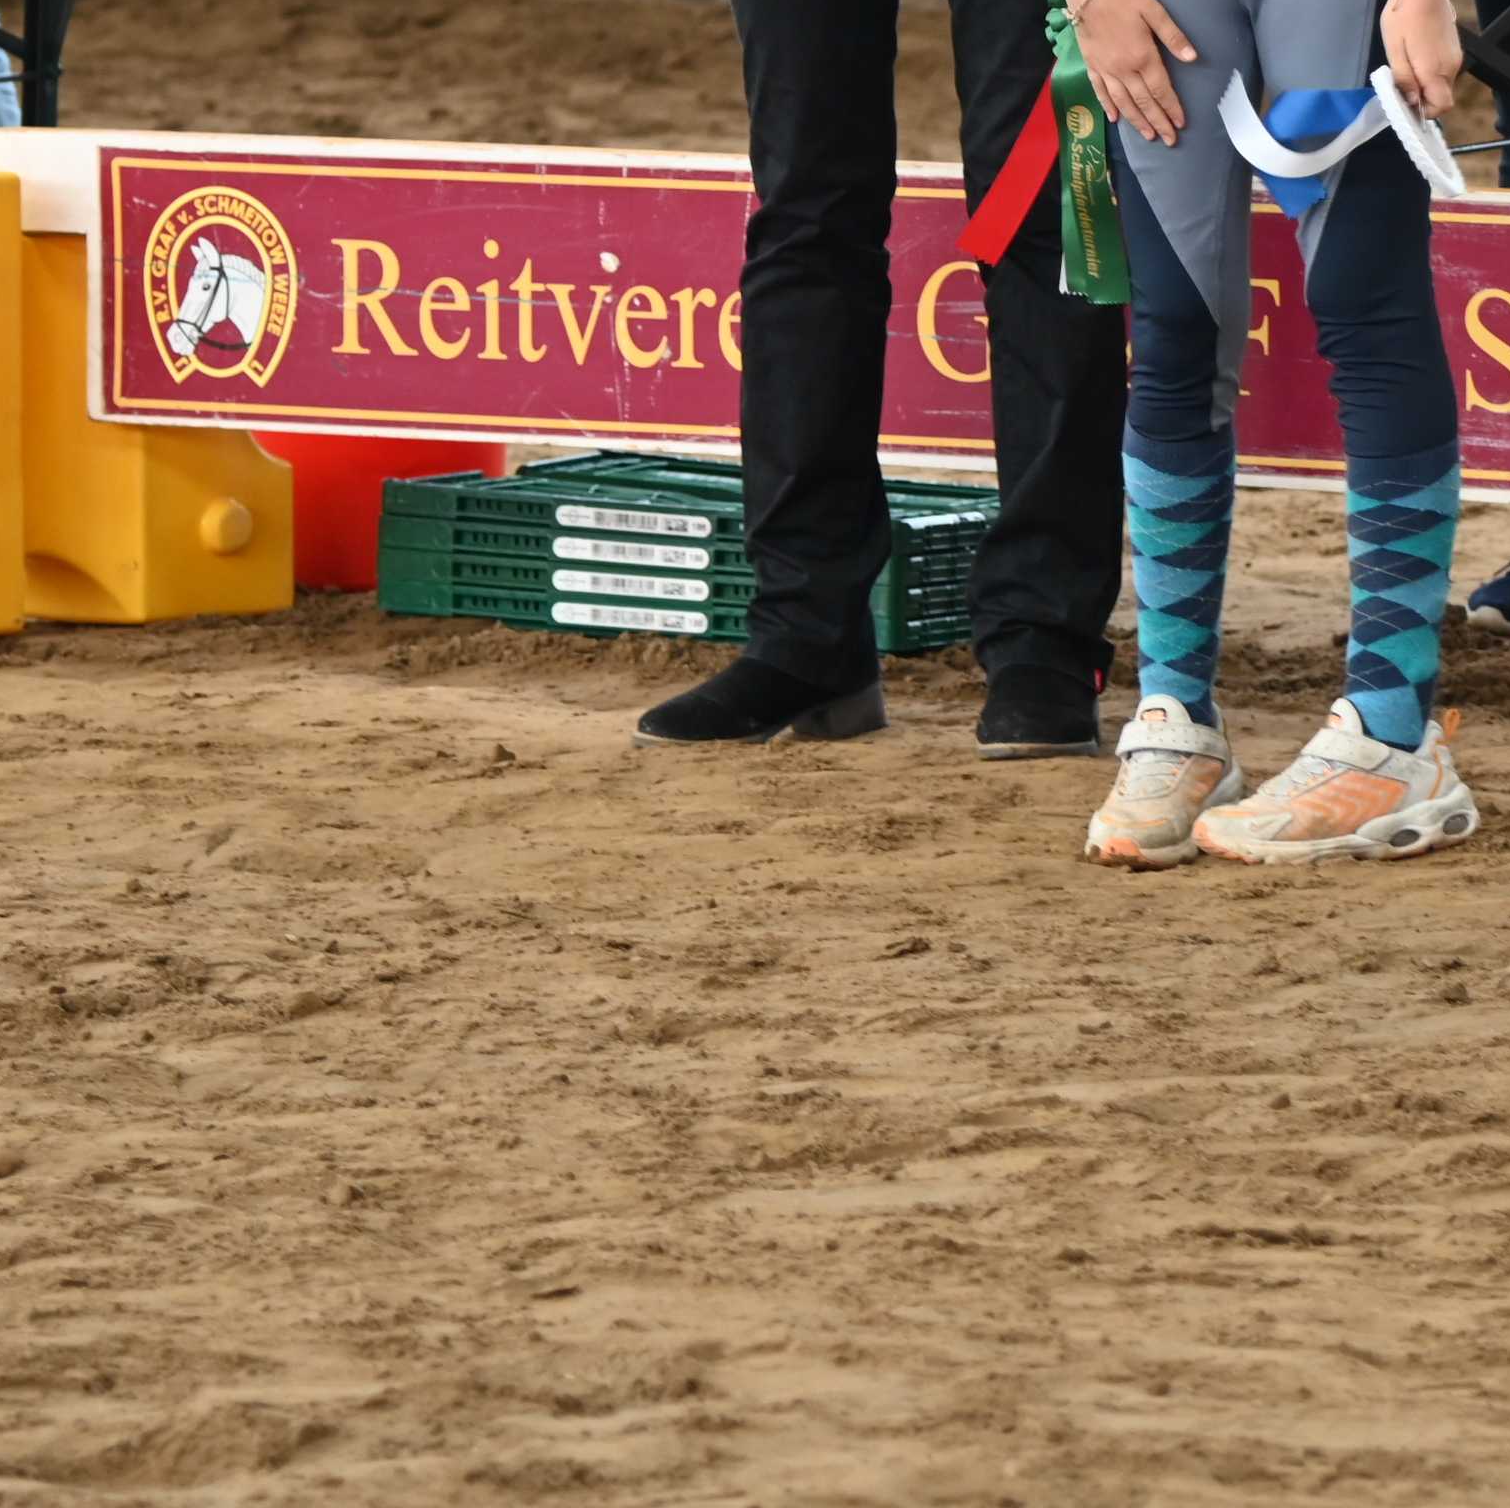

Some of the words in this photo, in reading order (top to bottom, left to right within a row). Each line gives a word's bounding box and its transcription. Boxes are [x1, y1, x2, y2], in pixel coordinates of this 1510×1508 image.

[152, 220, 179, 278] GRAF
[194, 195, 287, 265] SCHMETTOW
[266, 273, 288, 337] WEEZE
